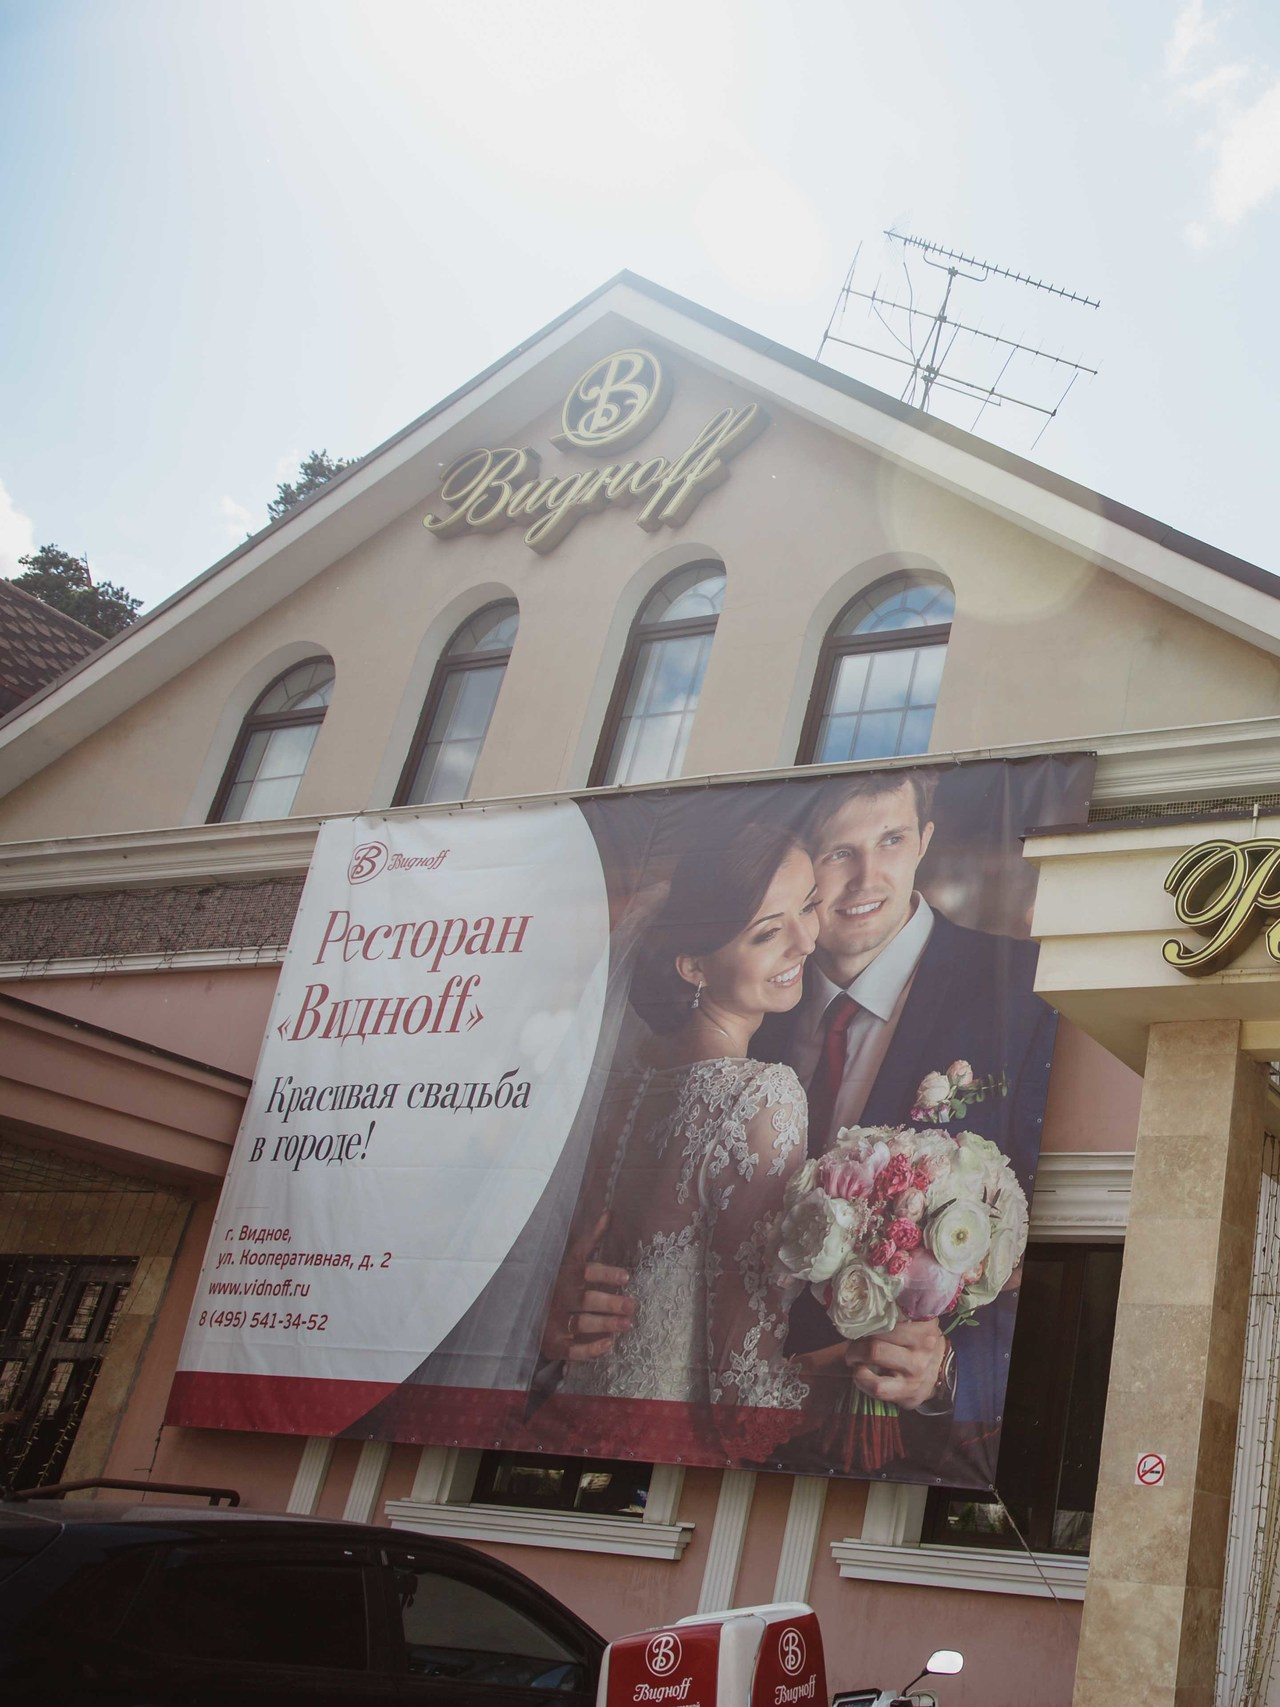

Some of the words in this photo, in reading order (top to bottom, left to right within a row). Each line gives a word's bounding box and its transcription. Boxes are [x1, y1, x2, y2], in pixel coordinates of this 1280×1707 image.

[312, 910, 533, 973] Ресторан
[264, 1075, 400, 1123] Красивая
[406, 1067, 532, 1115] свадьба
[248, 1136, 266, 1162] в
[270, 1120, 376, 1172] городе!
[224, 1228, 234, 1241] г.
[238, 1225, 292, 1244] Видное,
[216, 1251, 235, 1269] ул.
[239, 1249, 354, 1270] Кооперативная,
[357, 1254, 375, 1271] д.
[380, 1252, 392, 1268] 2
[208, 1279, 310, 1297] www.vidnoff.ru
[250, 1312, 328, 1331] 541-34-52
